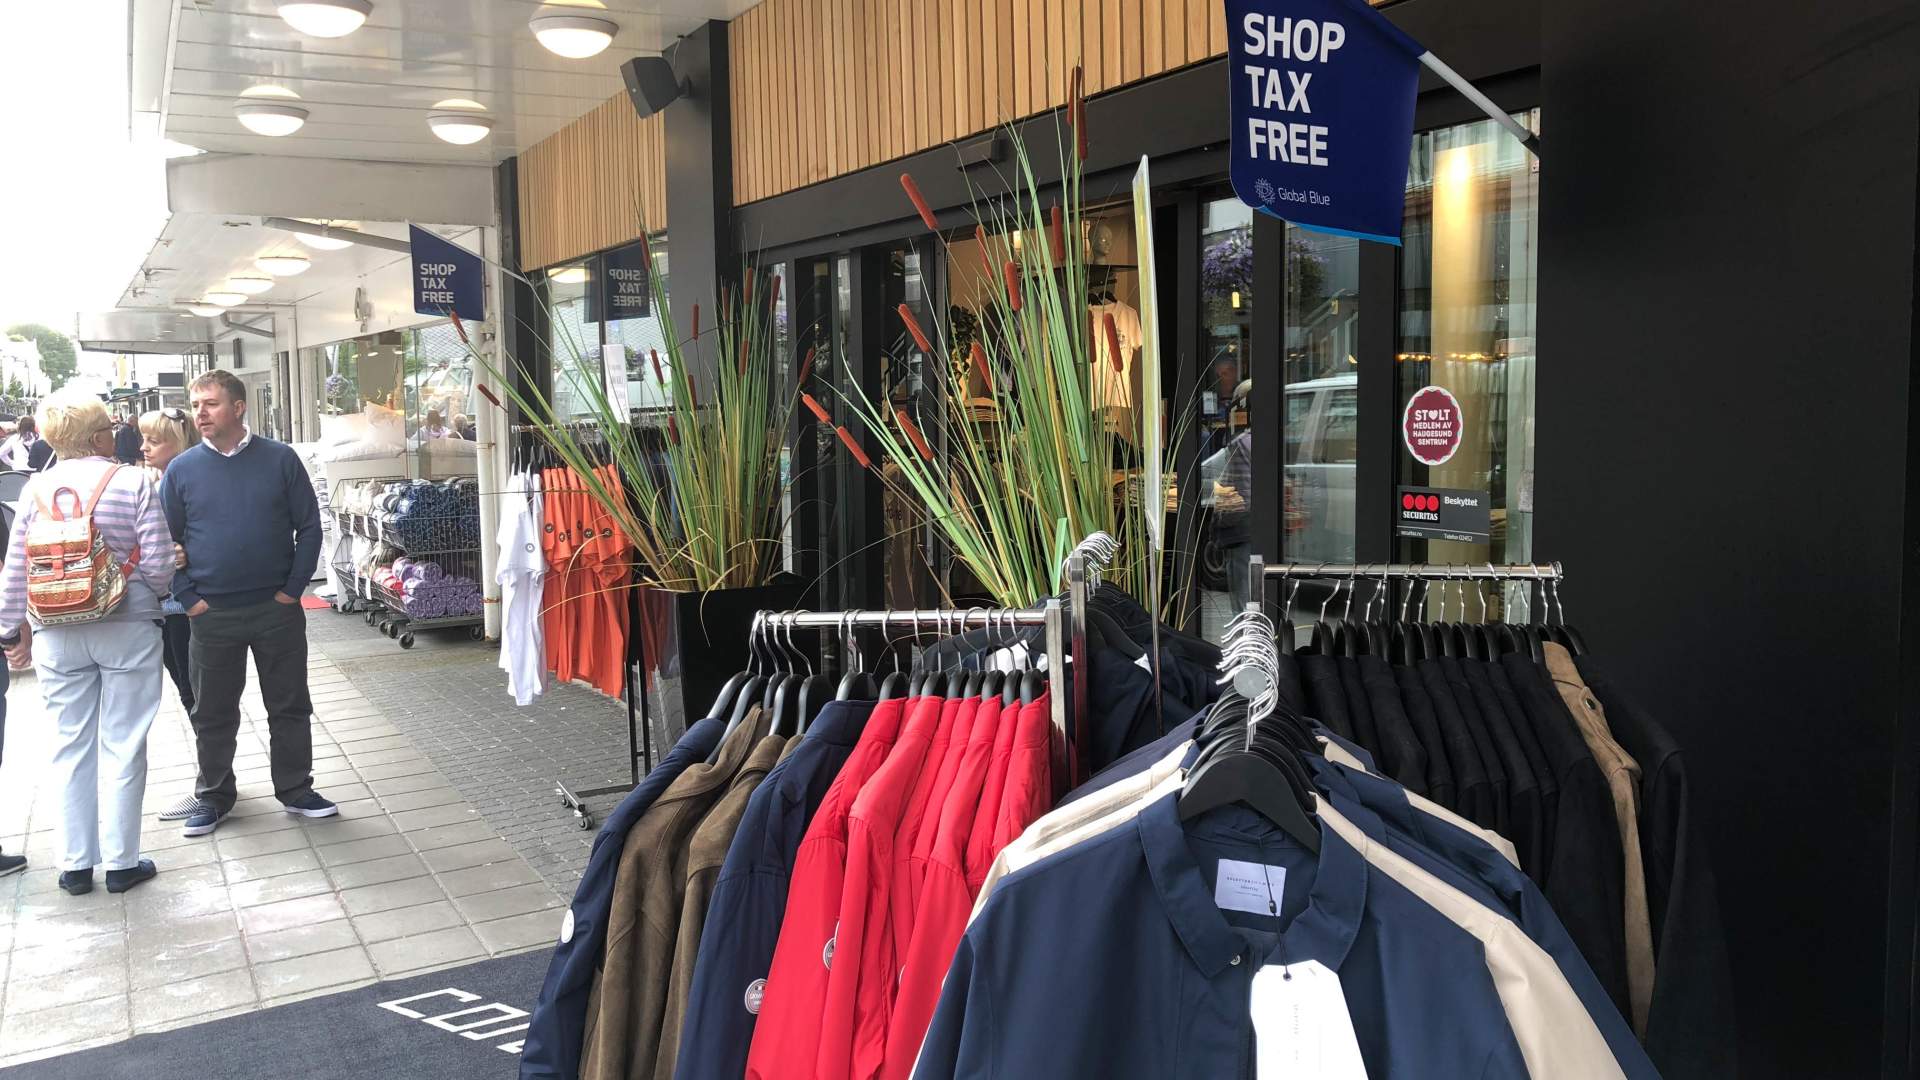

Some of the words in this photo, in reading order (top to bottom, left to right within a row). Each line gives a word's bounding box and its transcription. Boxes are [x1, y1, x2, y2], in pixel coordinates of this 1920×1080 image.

[1243, 12, 1346, 63] SHOP
[1244, 65, 1312, 114] TAX
[1248, 117, 1329, 167] FREE
[1277, 187, 1307, 203] Global
[1309, 189, 1331, 206] Blue
[420, 263, 457, 276] SHOP
[420, 277, 447, 289] TAX
[421, 291, 455, 304] FREE
[1413, 422, 1441, 430] MEDLEM
[1442, 421, 1452, 429] AV
[1412, 430, 1453, 438] HAUGESUND
[1417, 438, 1448, 446] SENTRUM
[1444, 496, 1478, 508] Beskyttet
[1402, 511, 1439, 521] SECURITAS
